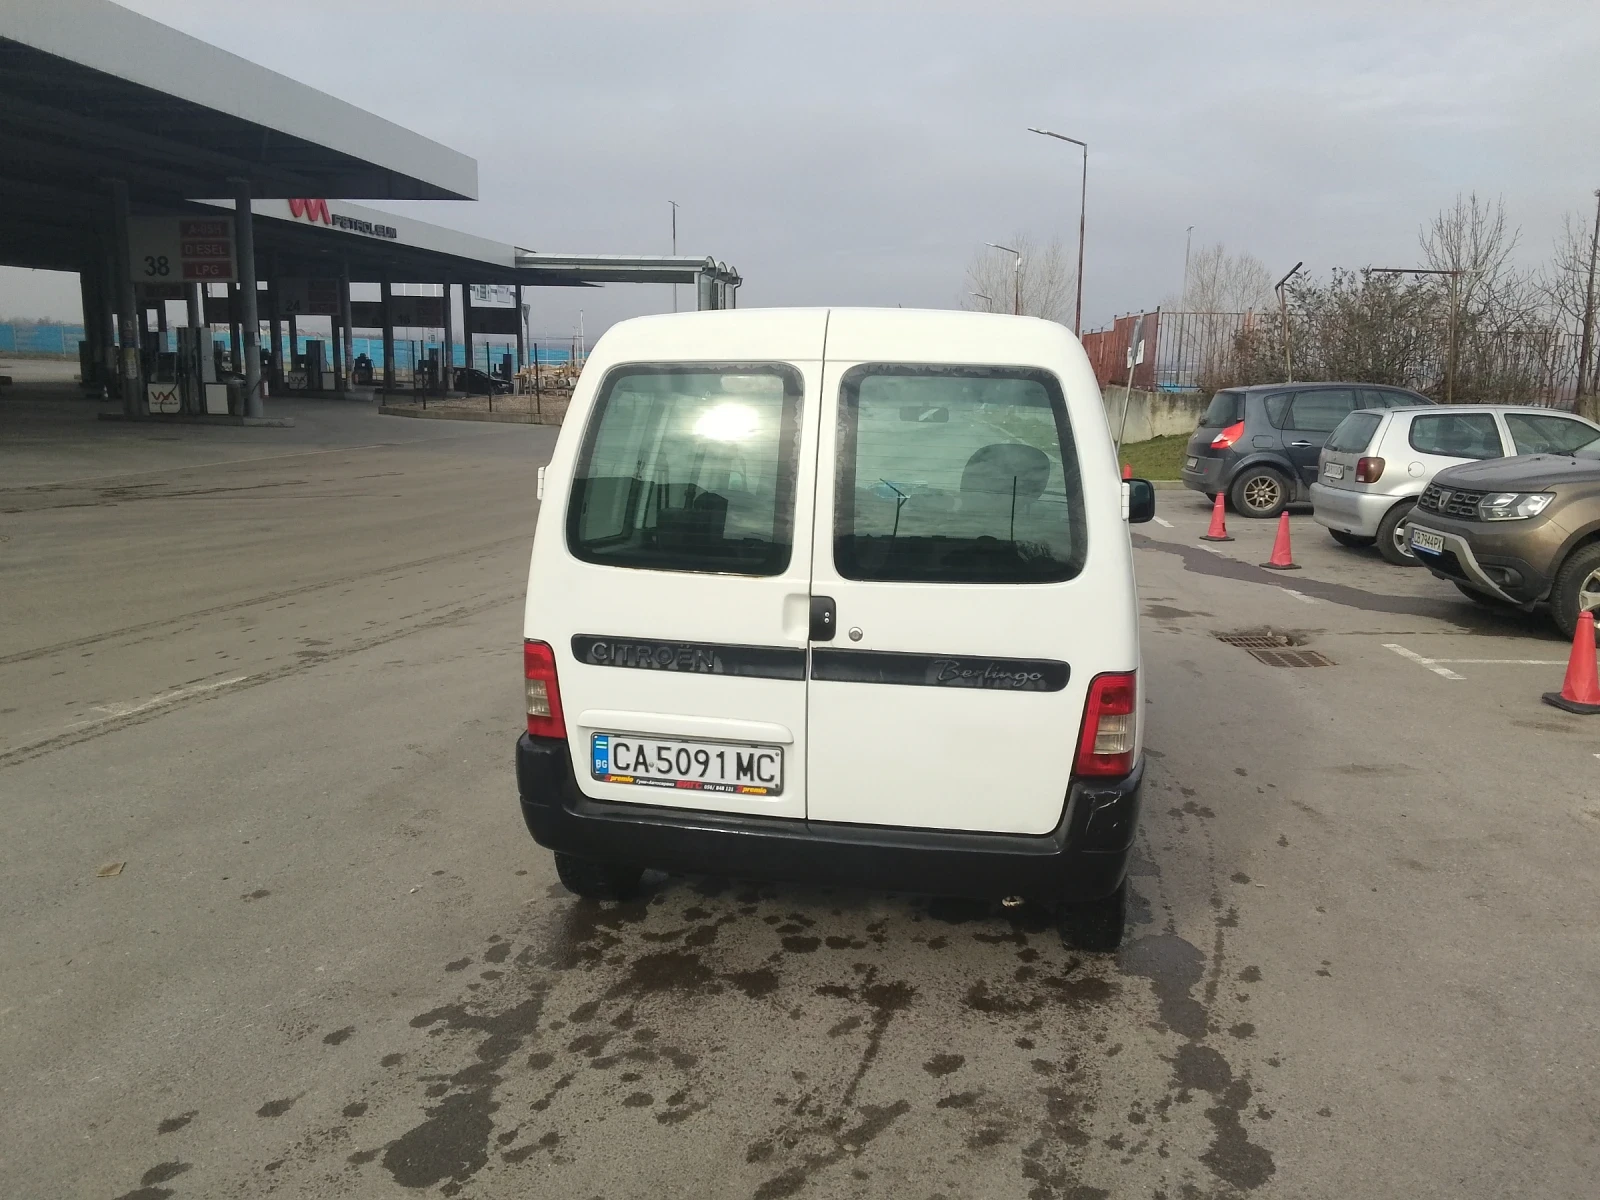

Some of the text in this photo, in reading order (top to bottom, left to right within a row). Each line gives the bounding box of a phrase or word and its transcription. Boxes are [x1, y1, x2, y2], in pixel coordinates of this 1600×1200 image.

[144, 256, 220, 276] 38 LPG
[591, 641, 716, 669] CITROËN
[934, 659, 1044, 687] Berlingo
[595, 759, 608, 769] BG
